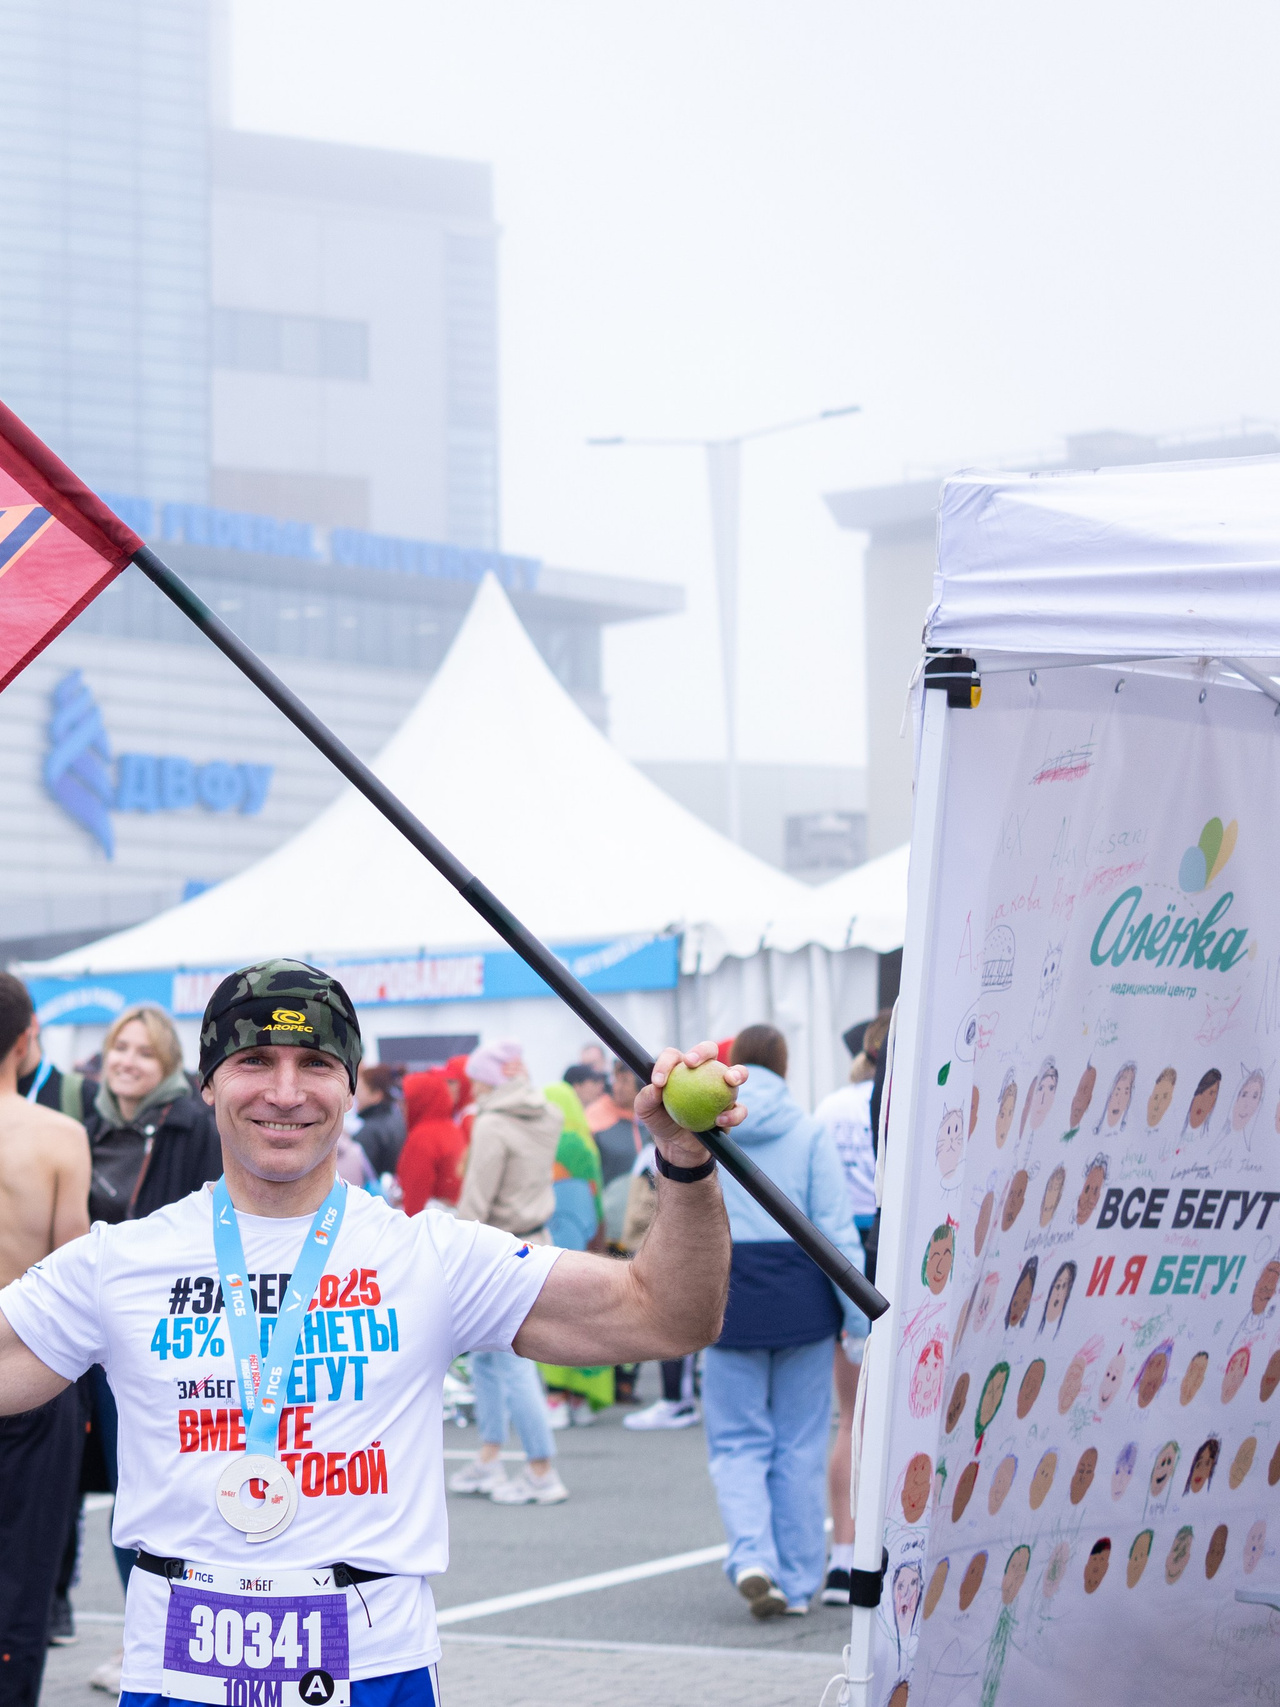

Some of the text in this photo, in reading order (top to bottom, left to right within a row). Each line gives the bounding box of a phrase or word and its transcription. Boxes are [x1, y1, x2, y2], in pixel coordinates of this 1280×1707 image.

[119, 754, 273, 814] ДВФУ
[1110, 982, 1197, 1000] медицинский центр
[263, 1023, 313, 1034] AROPEC
[321, 1206, 338, 1230] ПСБ
[1096, 1187, 1280, 1230] ВСЕ БЕГУТ
[1085, 1255, 1247, 1297] И Я БЕГУ!
[231, 1290, 247, 1317] ПСБ
[151, 1308, 399, 1360] 45% ПНЕТЫ
[263, 1356, 368, 1404] ЕГУТ
[266, 1366, 283, 1396] ПСБ
[179, 1406, 314, 1453] ВМЕТЕ
[281, 1441, 388, 1497] ТОБОЙ
[195, 1571, 214, 1583] ПСБ
[189, 1604, 322, 1669] 30341
